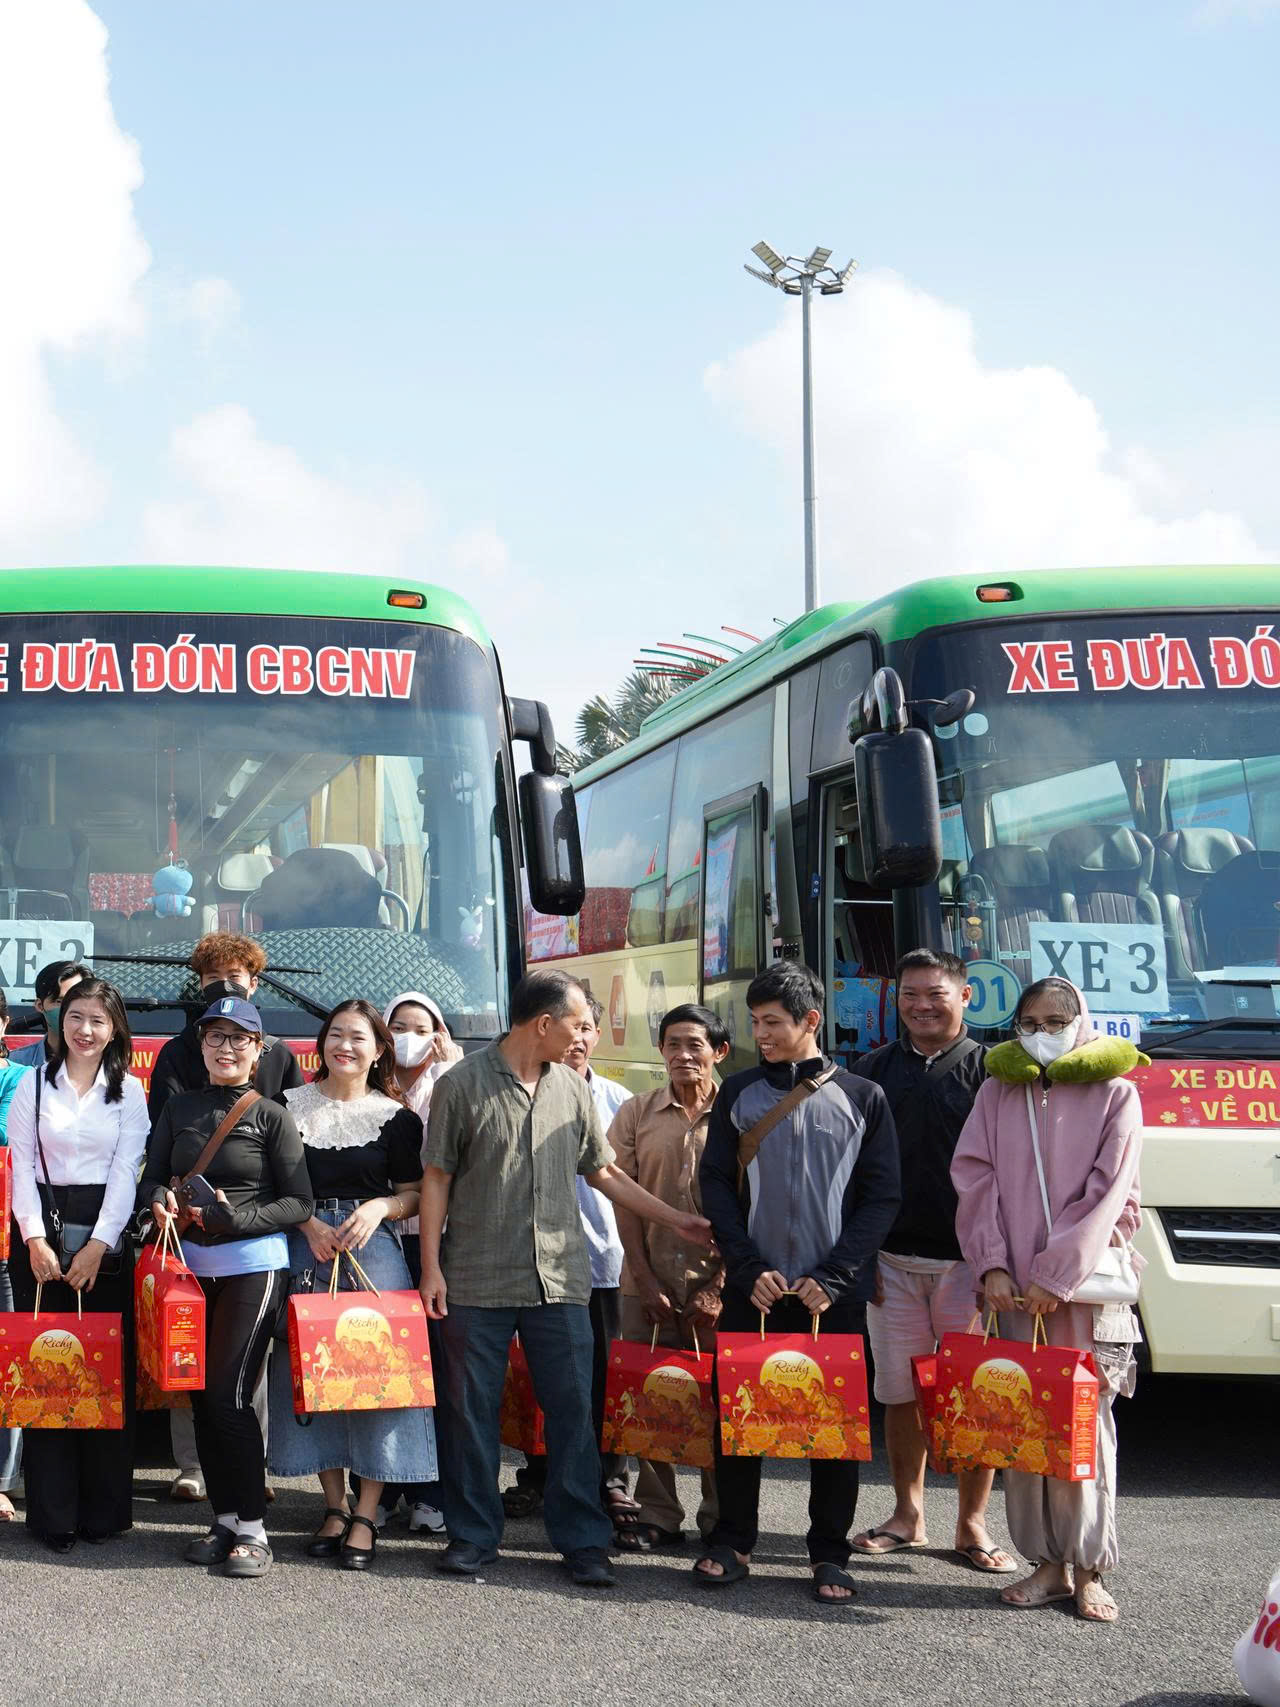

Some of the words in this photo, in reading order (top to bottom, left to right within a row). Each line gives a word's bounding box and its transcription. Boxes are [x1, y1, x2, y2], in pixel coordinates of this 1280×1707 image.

[21, 638, 124, 693] ĐƯA
[131, 633, 237, 693] ĐÓN
[246, 644, 416, 699] CBCNV
[1001, 641, 1079, 693] XE
[1087, 633, 1205, 690] ĐƯA
[1038, 940, 1111, 993] XE
[1128, 942, 1158, 994] 3
[967, 976, 1006, 1012] 01
[1169, 1069, 1207, 1089] XE
[1214, 1066, 1277, 1090] ĐƯA
[1200, 1094, 1239, 1121] VỀ
[40, 1334, 72, 1357] Richy
[772, 1358, 809, 1383] Richy
[984, 1366, 1019, 1391] Richy
